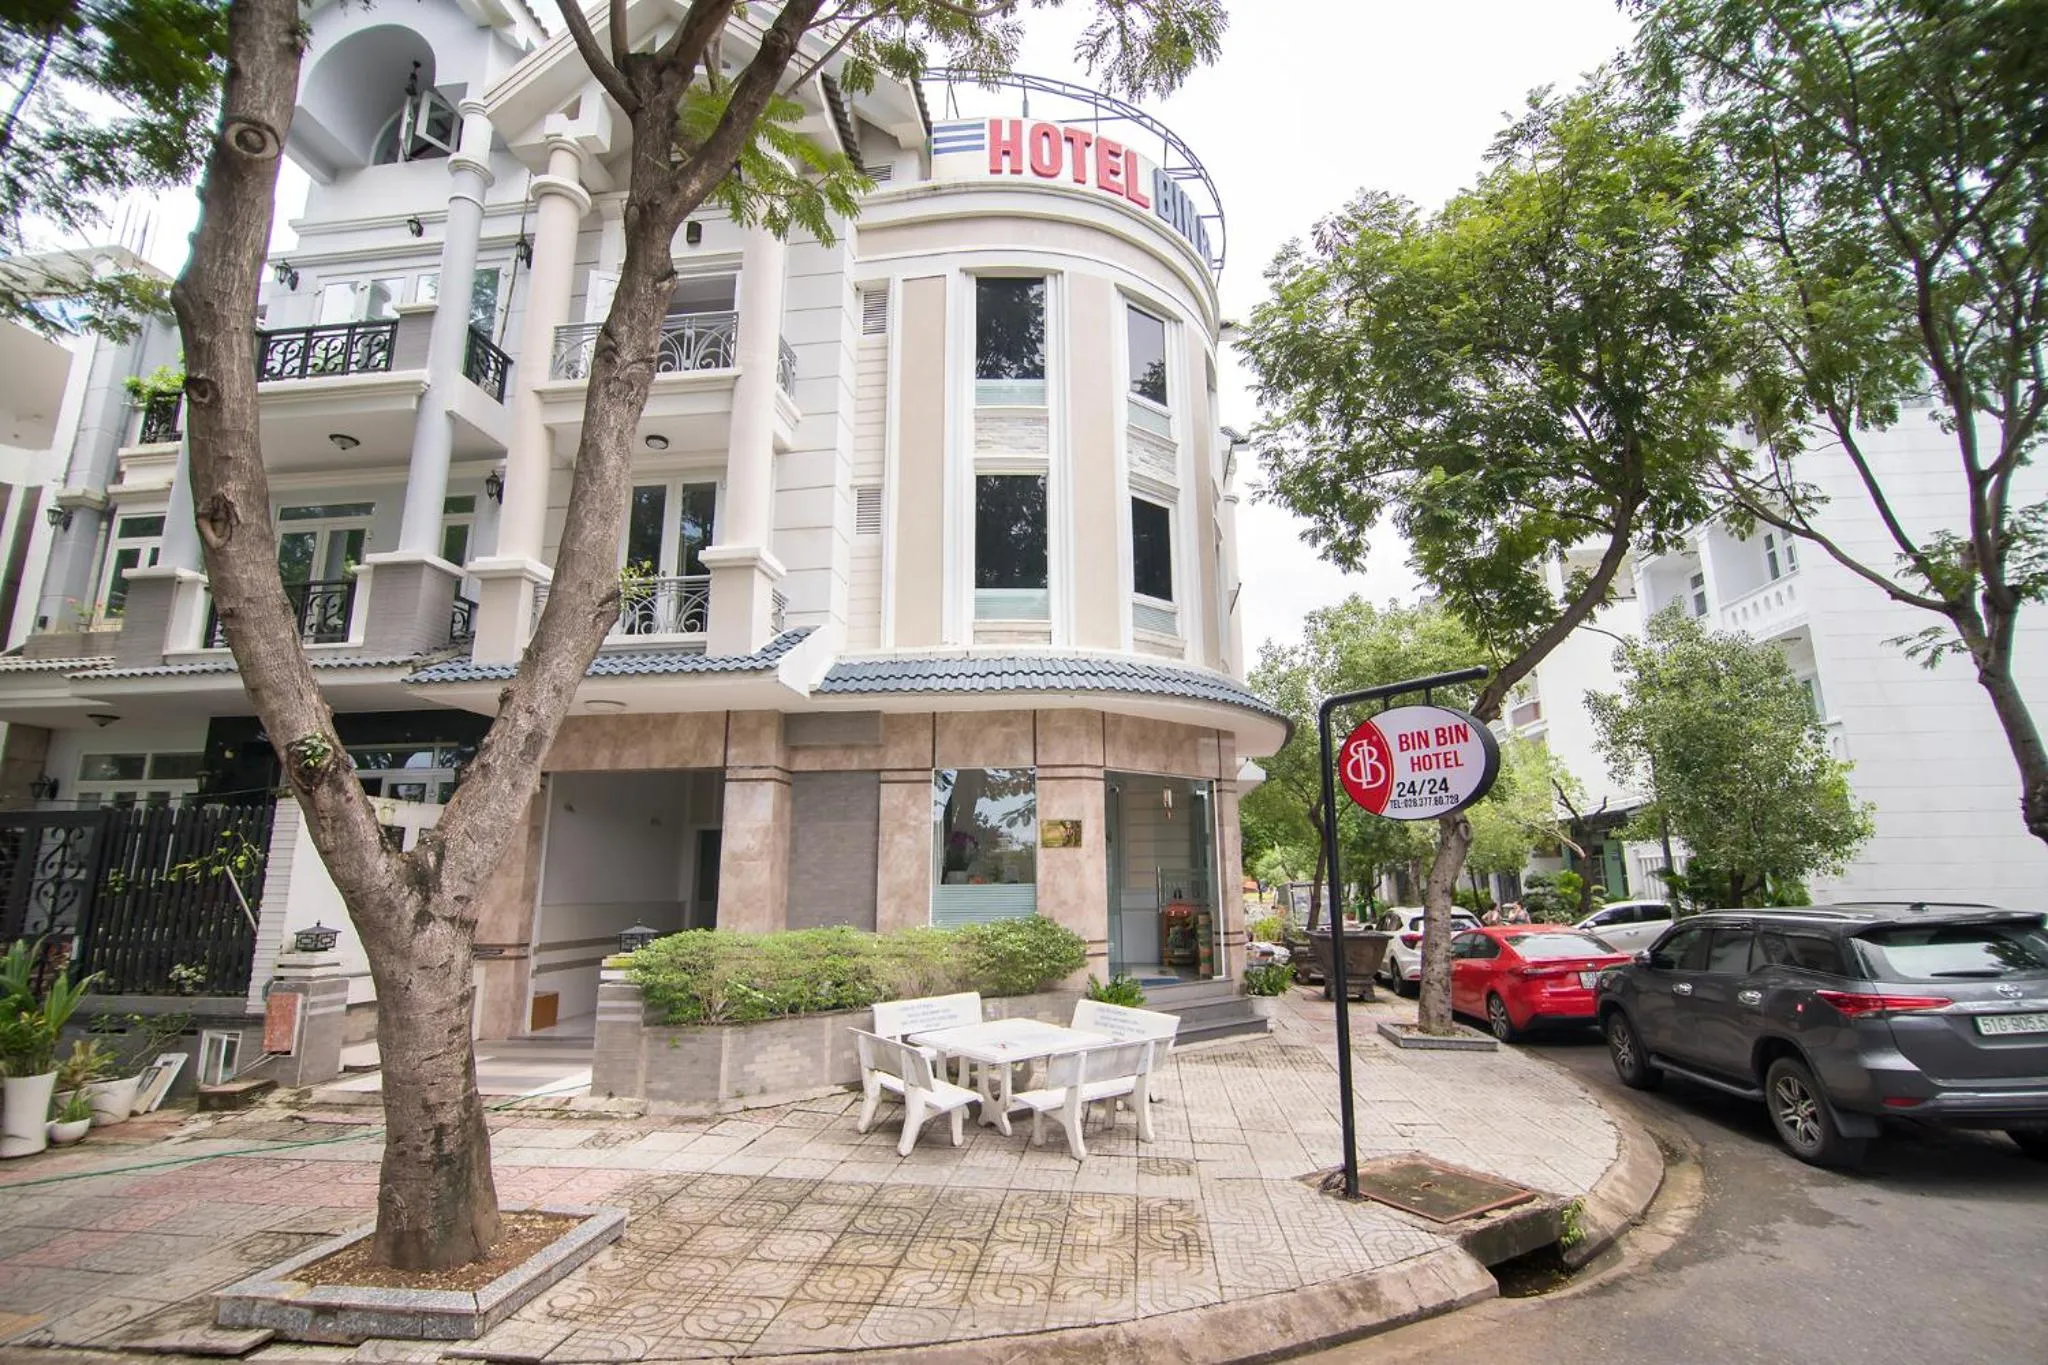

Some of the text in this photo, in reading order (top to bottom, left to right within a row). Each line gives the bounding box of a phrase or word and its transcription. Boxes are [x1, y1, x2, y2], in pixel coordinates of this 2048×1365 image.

[989, 118, 1150, 209] HOTEL
[1398, 723, 1469, 752] BIN BIN
[1410, 750, 1464, 772] HOTEL
[1396, 777, 1449, 798] 24/24
